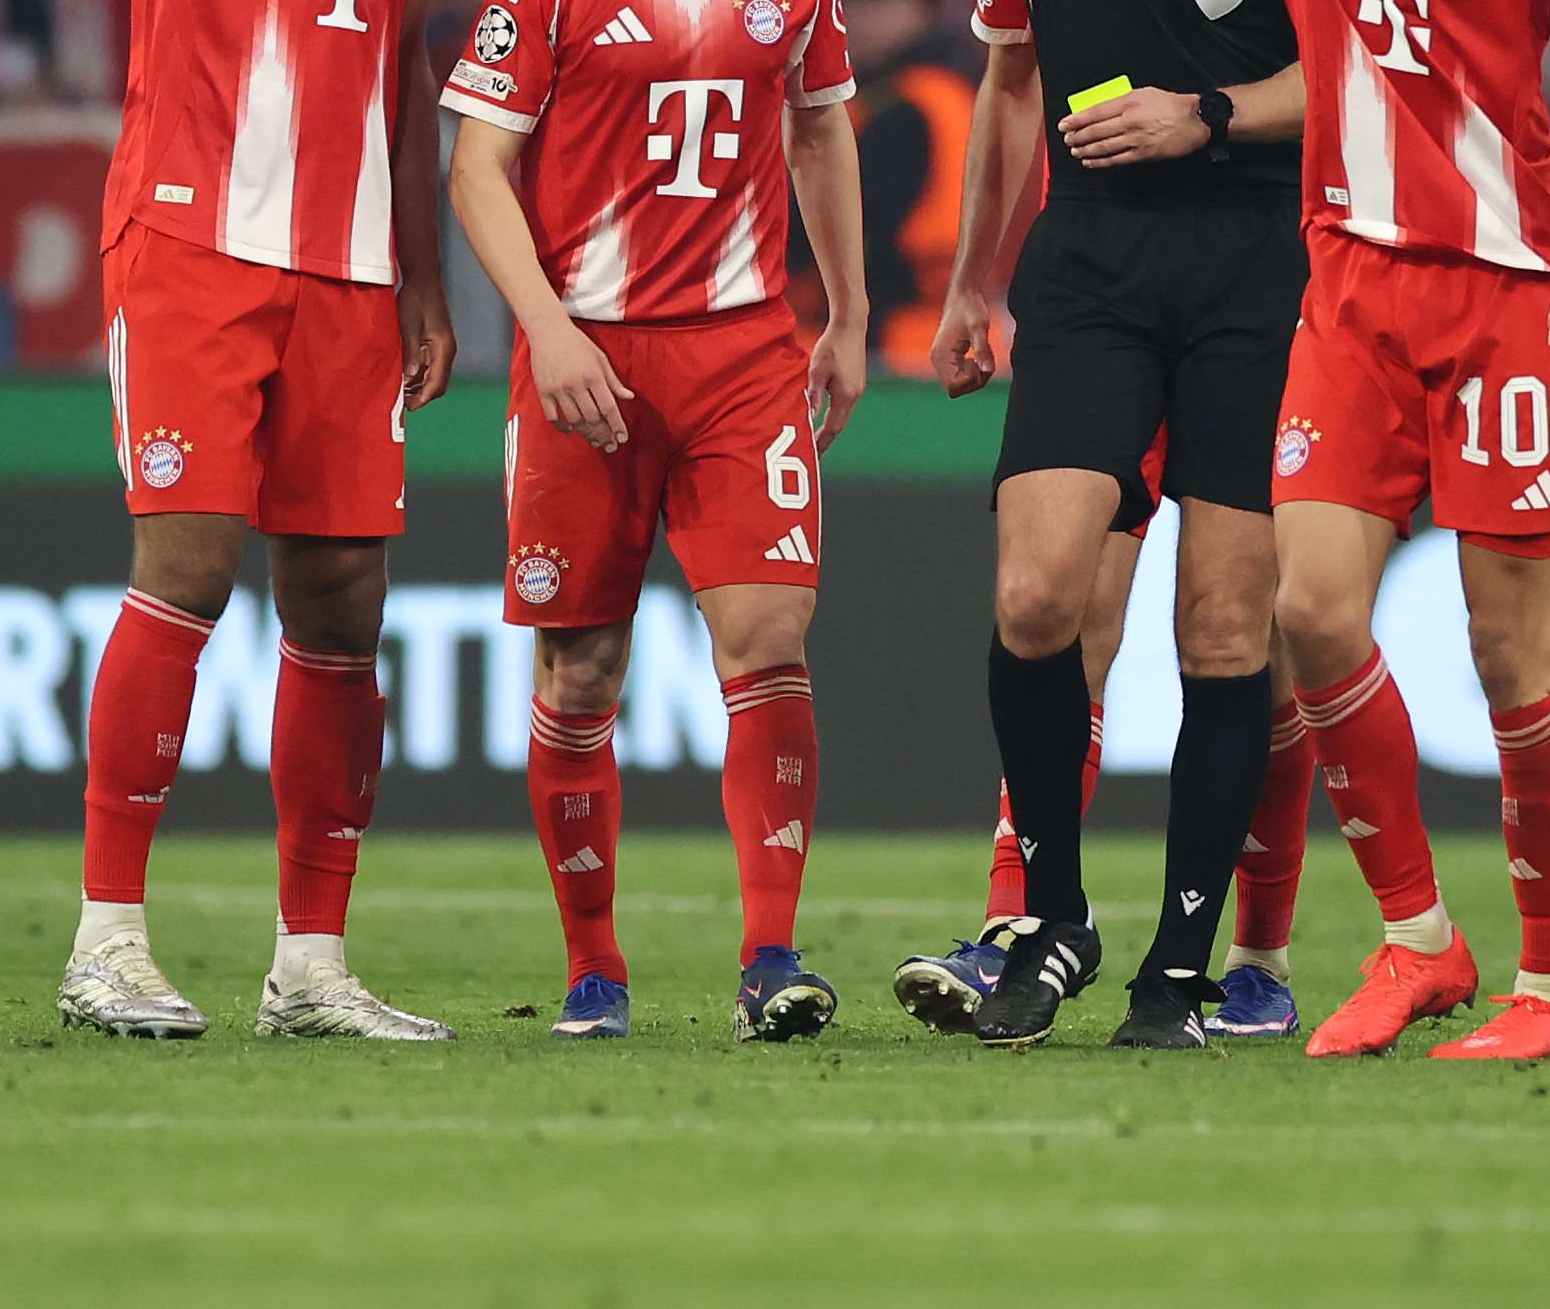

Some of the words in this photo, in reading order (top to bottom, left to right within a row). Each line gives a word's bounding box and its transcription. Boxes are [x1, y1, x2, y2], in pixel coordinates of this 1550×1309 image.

[647, 79, 744, 198] T
[765, 425, 811, 509] 6
[1457, 376, 1550, 467] 10
